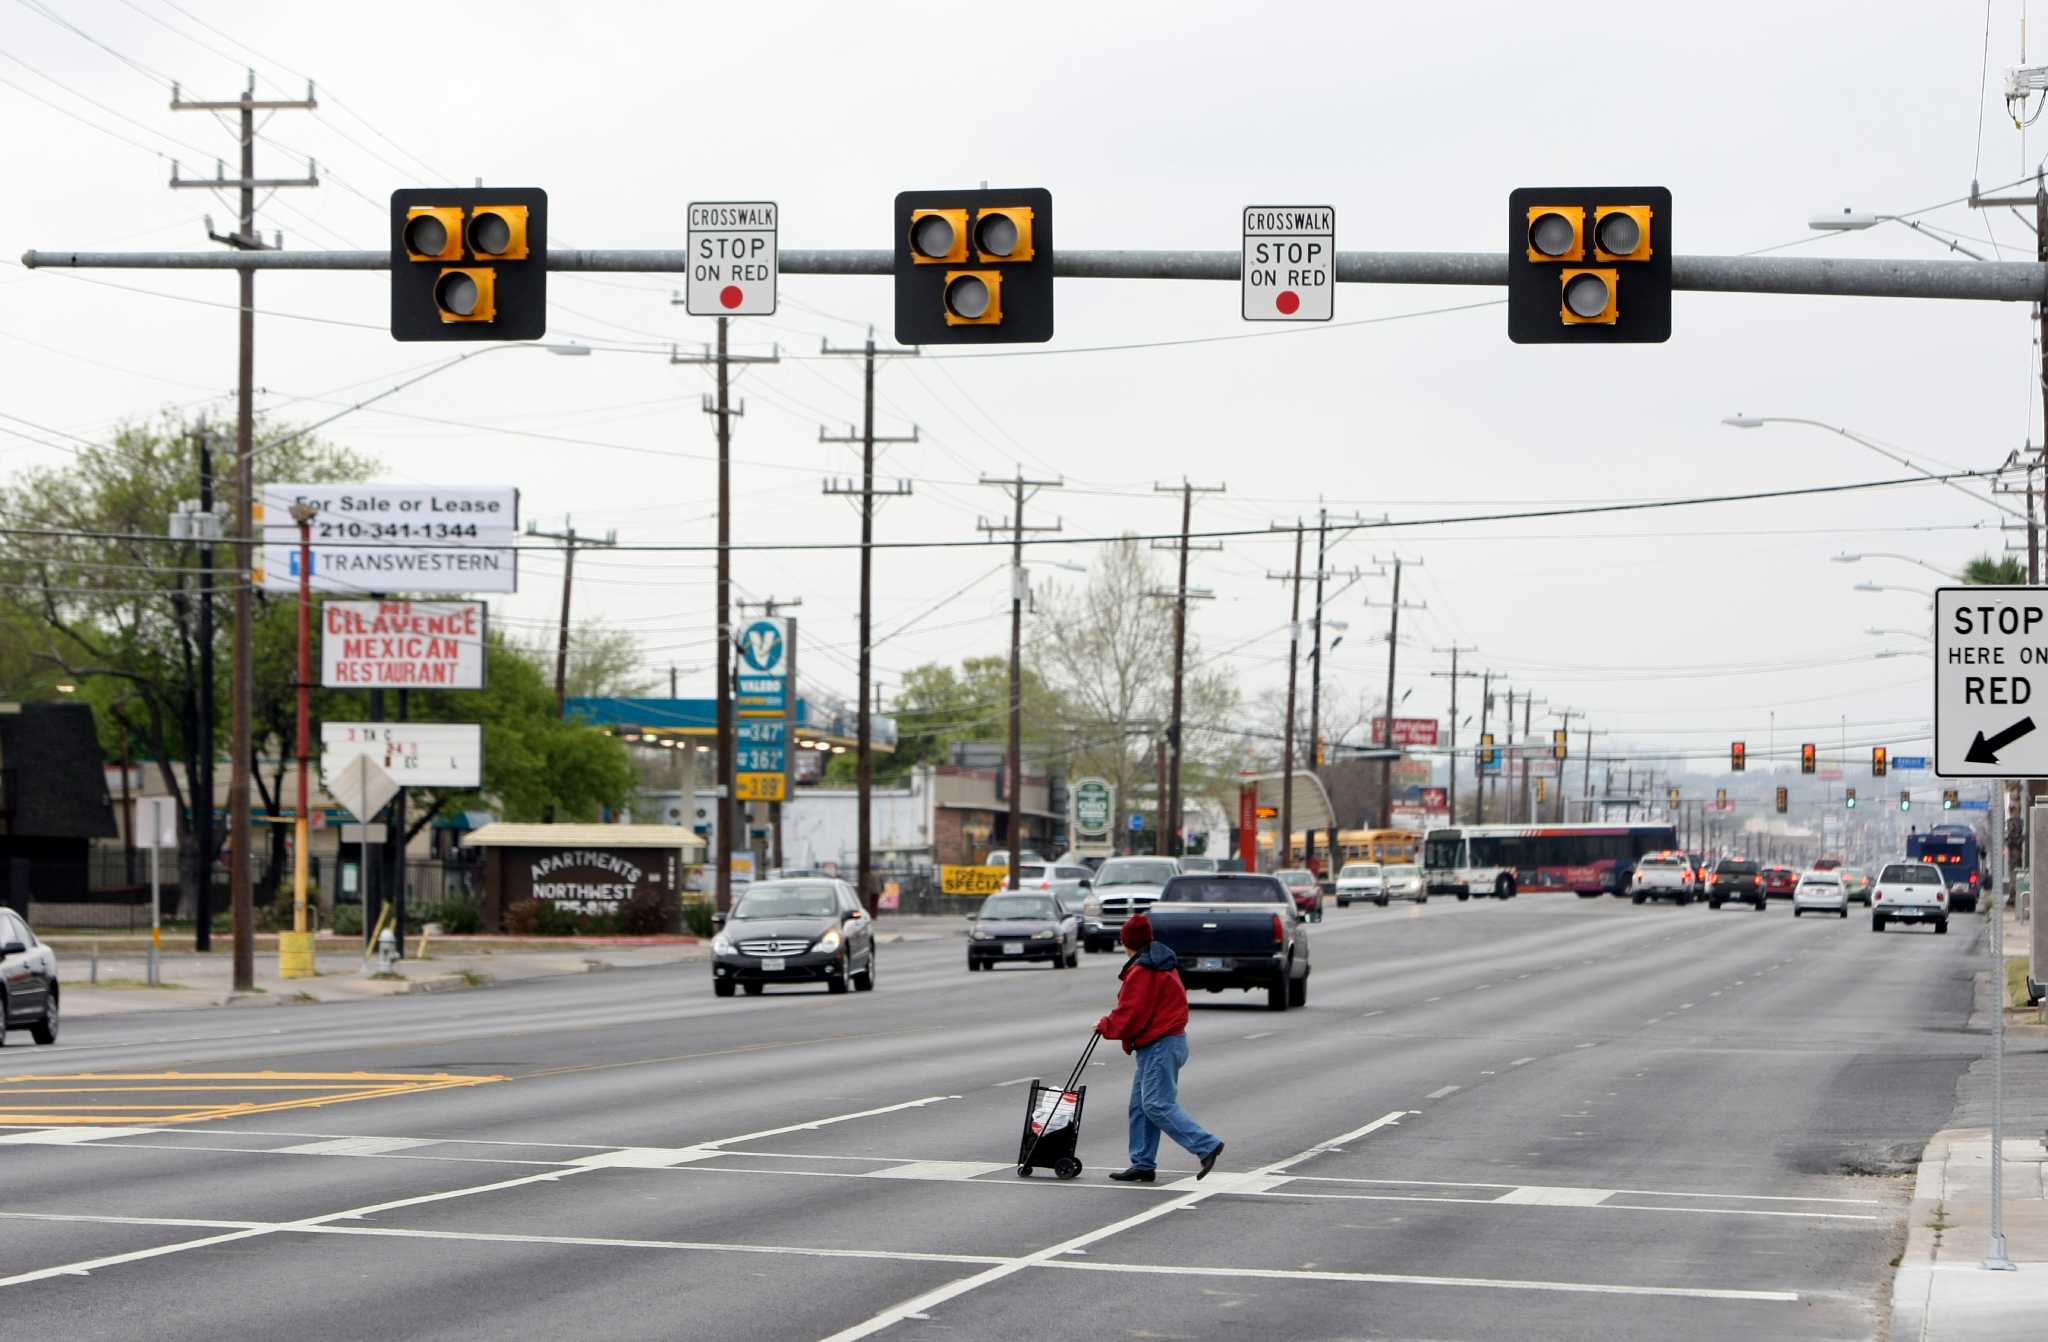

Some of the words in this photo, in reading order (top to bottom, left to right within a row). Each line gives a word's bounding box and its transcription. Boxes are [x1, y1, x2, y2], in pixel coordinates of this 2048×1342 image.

[692, 208, 773, 226] CROSSWALK
[1248, 212, 1330, 230] CROSSWALK
[700, 238, 765, 259] STOP
[1256, 243, 1322, 264] STOP
[695, 264, 720, 282] ON
[732, 264, 769, 281] RED
[1251, 269, 1276, 286] ON
[1288, 269, 1326, 286] RED
[340, 496, 391, 513] Sale
[399, 499, 423, 513] or
[431, 496, 500, 513] Lease
[319, 523, 478, 538] 210-341-1344
[322, 554, 500, 571] TRANSWESTERN
[1954, 606, 2043, 635] STOP
[343, 638, 459, 659] MEXICAN
[1949, 647, 2005, 664] HERE
[2020, 647, 2048, 664] ON
[336, 661, 459, 684] RESTAURANT
[1966, 676, 2032, 704] RED
[530, 850, 643, 883] APARTMENTS
[532, 883, 636, 899] NORTHWEST
[944, 880, 1002, 891] SPECIA
